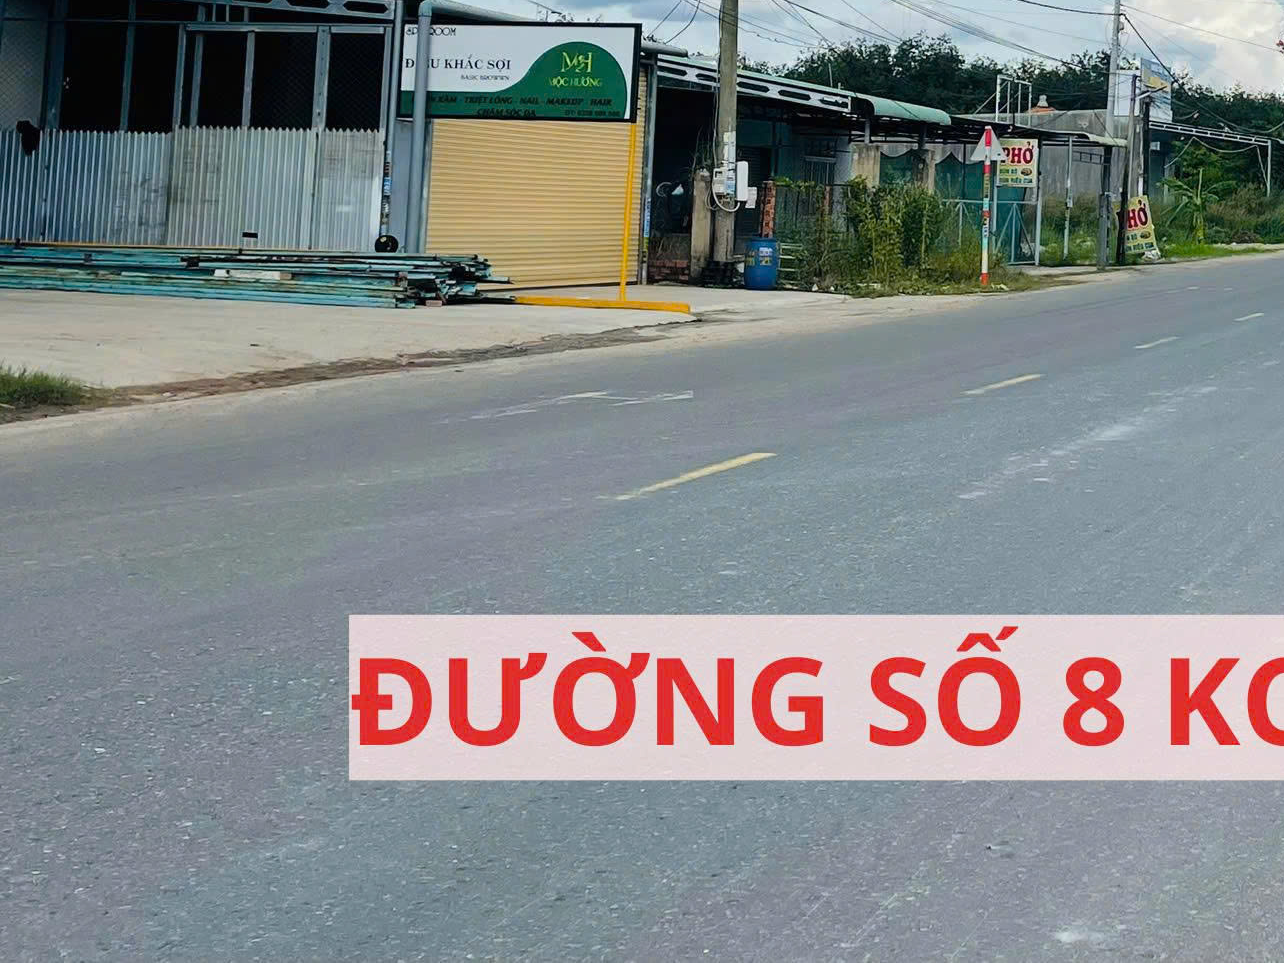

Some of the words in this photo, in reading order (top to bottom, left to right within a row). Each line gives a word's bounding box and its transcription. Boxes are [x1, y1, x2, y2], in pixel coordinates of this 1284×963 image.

[445, 54, 484, 70] KHẮC
[487, 58, 511, 72] SỢI
[1001, 141, 1034, 164] PHỞ
